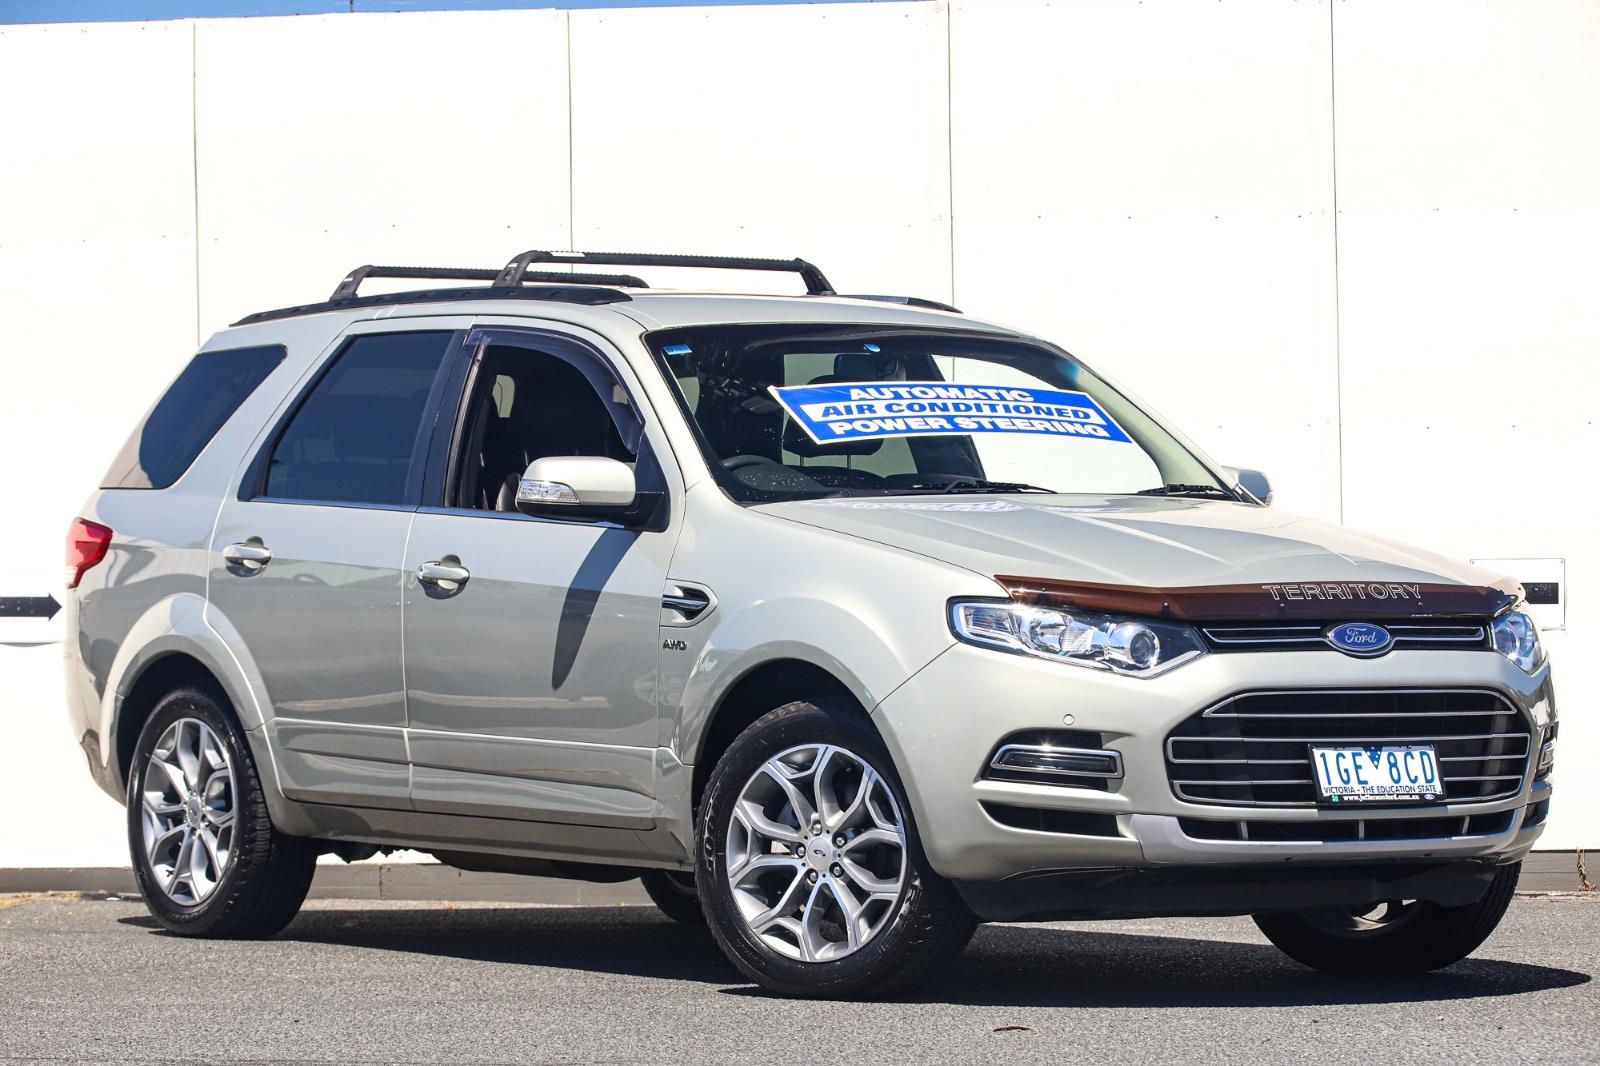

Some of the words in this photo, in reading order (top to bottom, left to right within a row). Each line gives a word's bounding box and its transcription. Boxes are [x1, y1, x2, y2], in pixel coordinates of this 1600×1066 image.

[850, 387, 1034, 402] AUTOMATIC
[821, 403, 878, 418] AIR
[884, 402, 1092, 420] CONDITIONED
[828, 417, 954, 435] POWER
[953, 416, 1111, 438] STEERING
[1262, 583, 1422, 600] TERRITORY
[1344, 627, 1377, 644] Ford
[1320, 752, 1368, 785] 1GE
[1386, 751, 1435, 784] 8CD
[1323, 786, 1355, 794] VICTORIA
[1377, 785, 1415, 793] EDUCATION
[1417, 784, 1436, 793] STATE
